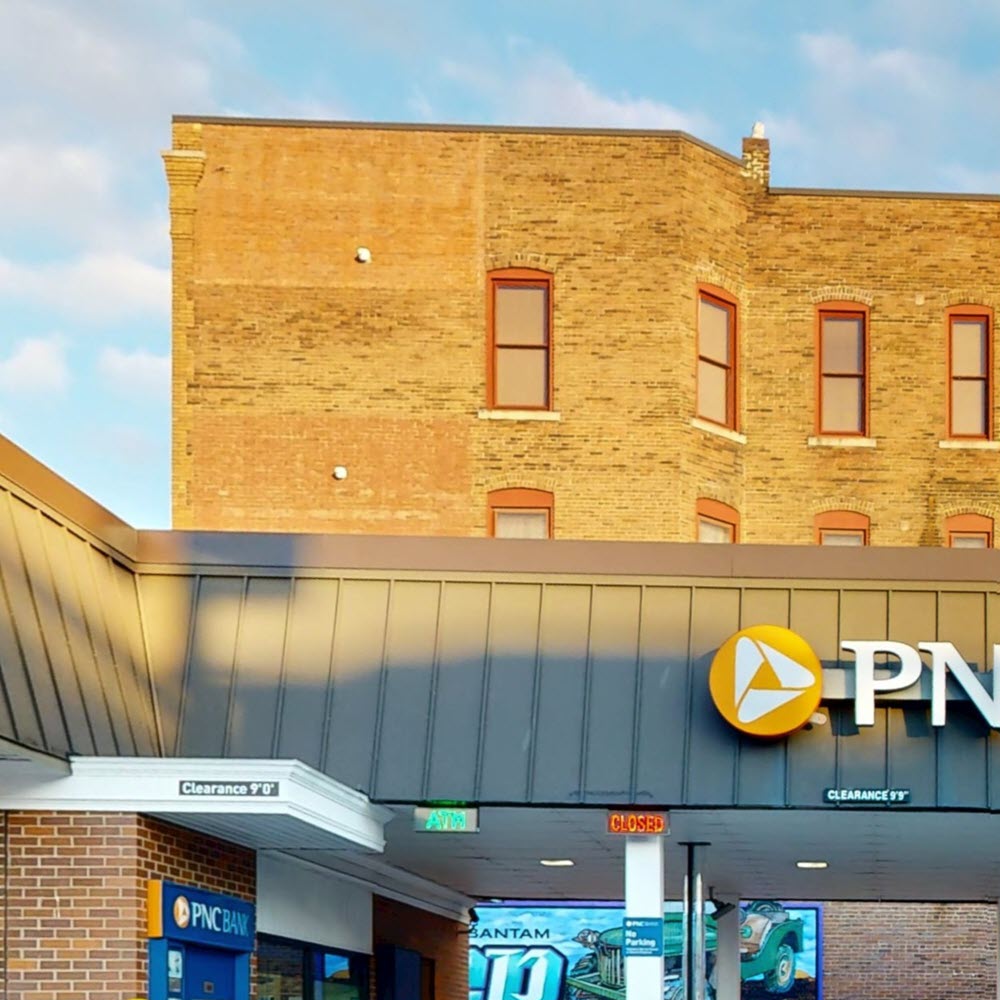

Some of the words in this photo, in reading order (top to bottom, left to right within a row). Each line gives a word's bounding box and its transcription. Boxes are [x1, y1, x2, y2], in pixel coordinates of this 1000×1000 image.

[182, 782, 247, 795] Clearance
[827, 789, 888, 801] CLEARANCE
[425, 810, 467, 830] ATM
[611, 814, 665, 833] CLOSED
